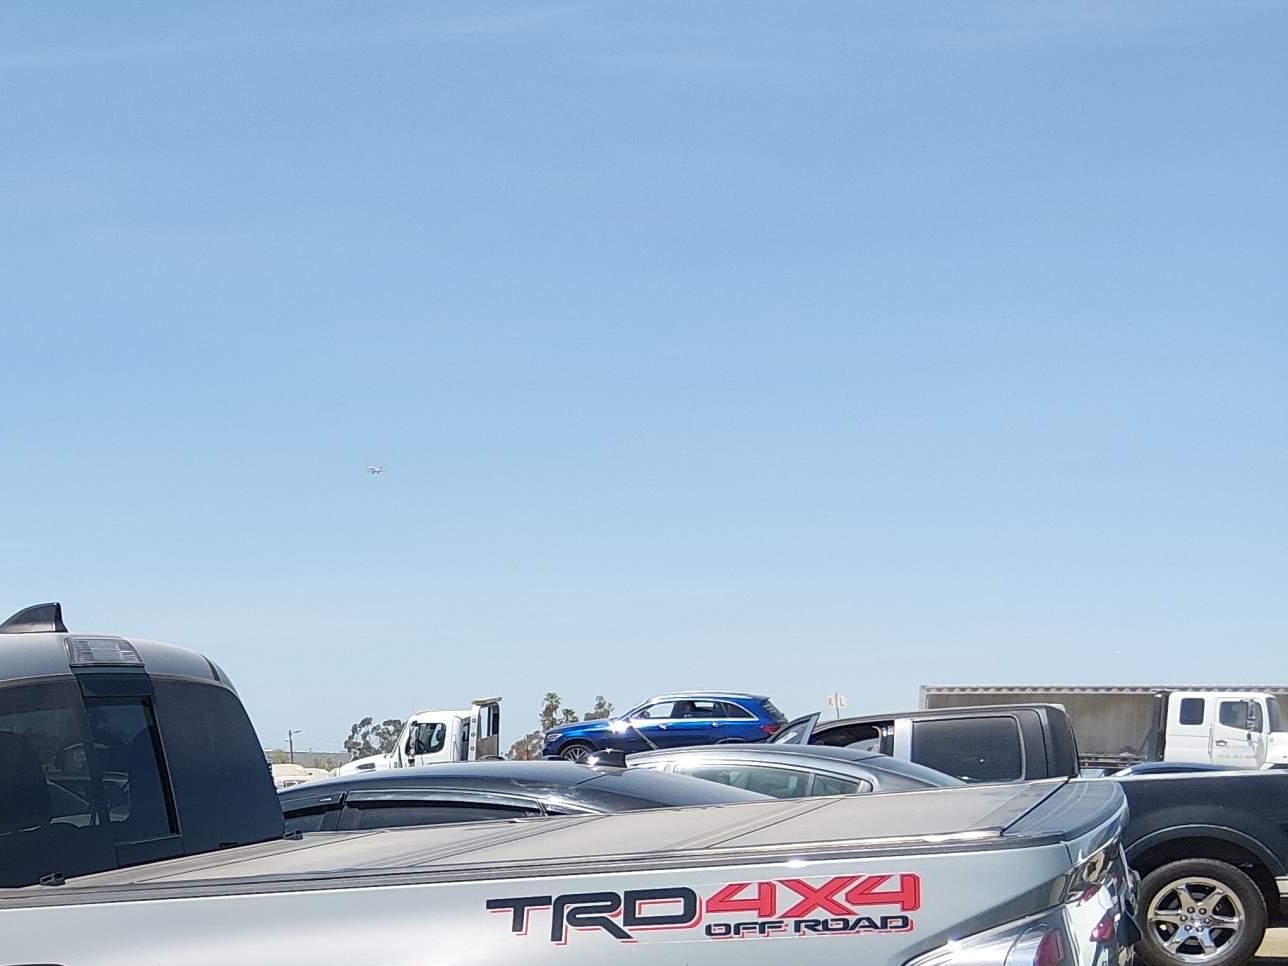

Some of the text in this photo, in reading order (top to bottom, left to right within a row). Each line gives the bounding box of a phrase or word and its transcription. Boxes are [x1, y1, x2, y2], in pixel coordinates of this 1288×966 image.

[486, 873, 920, 946] TRD 4X4
[704, 914, 915, 939] OFF ROAD
